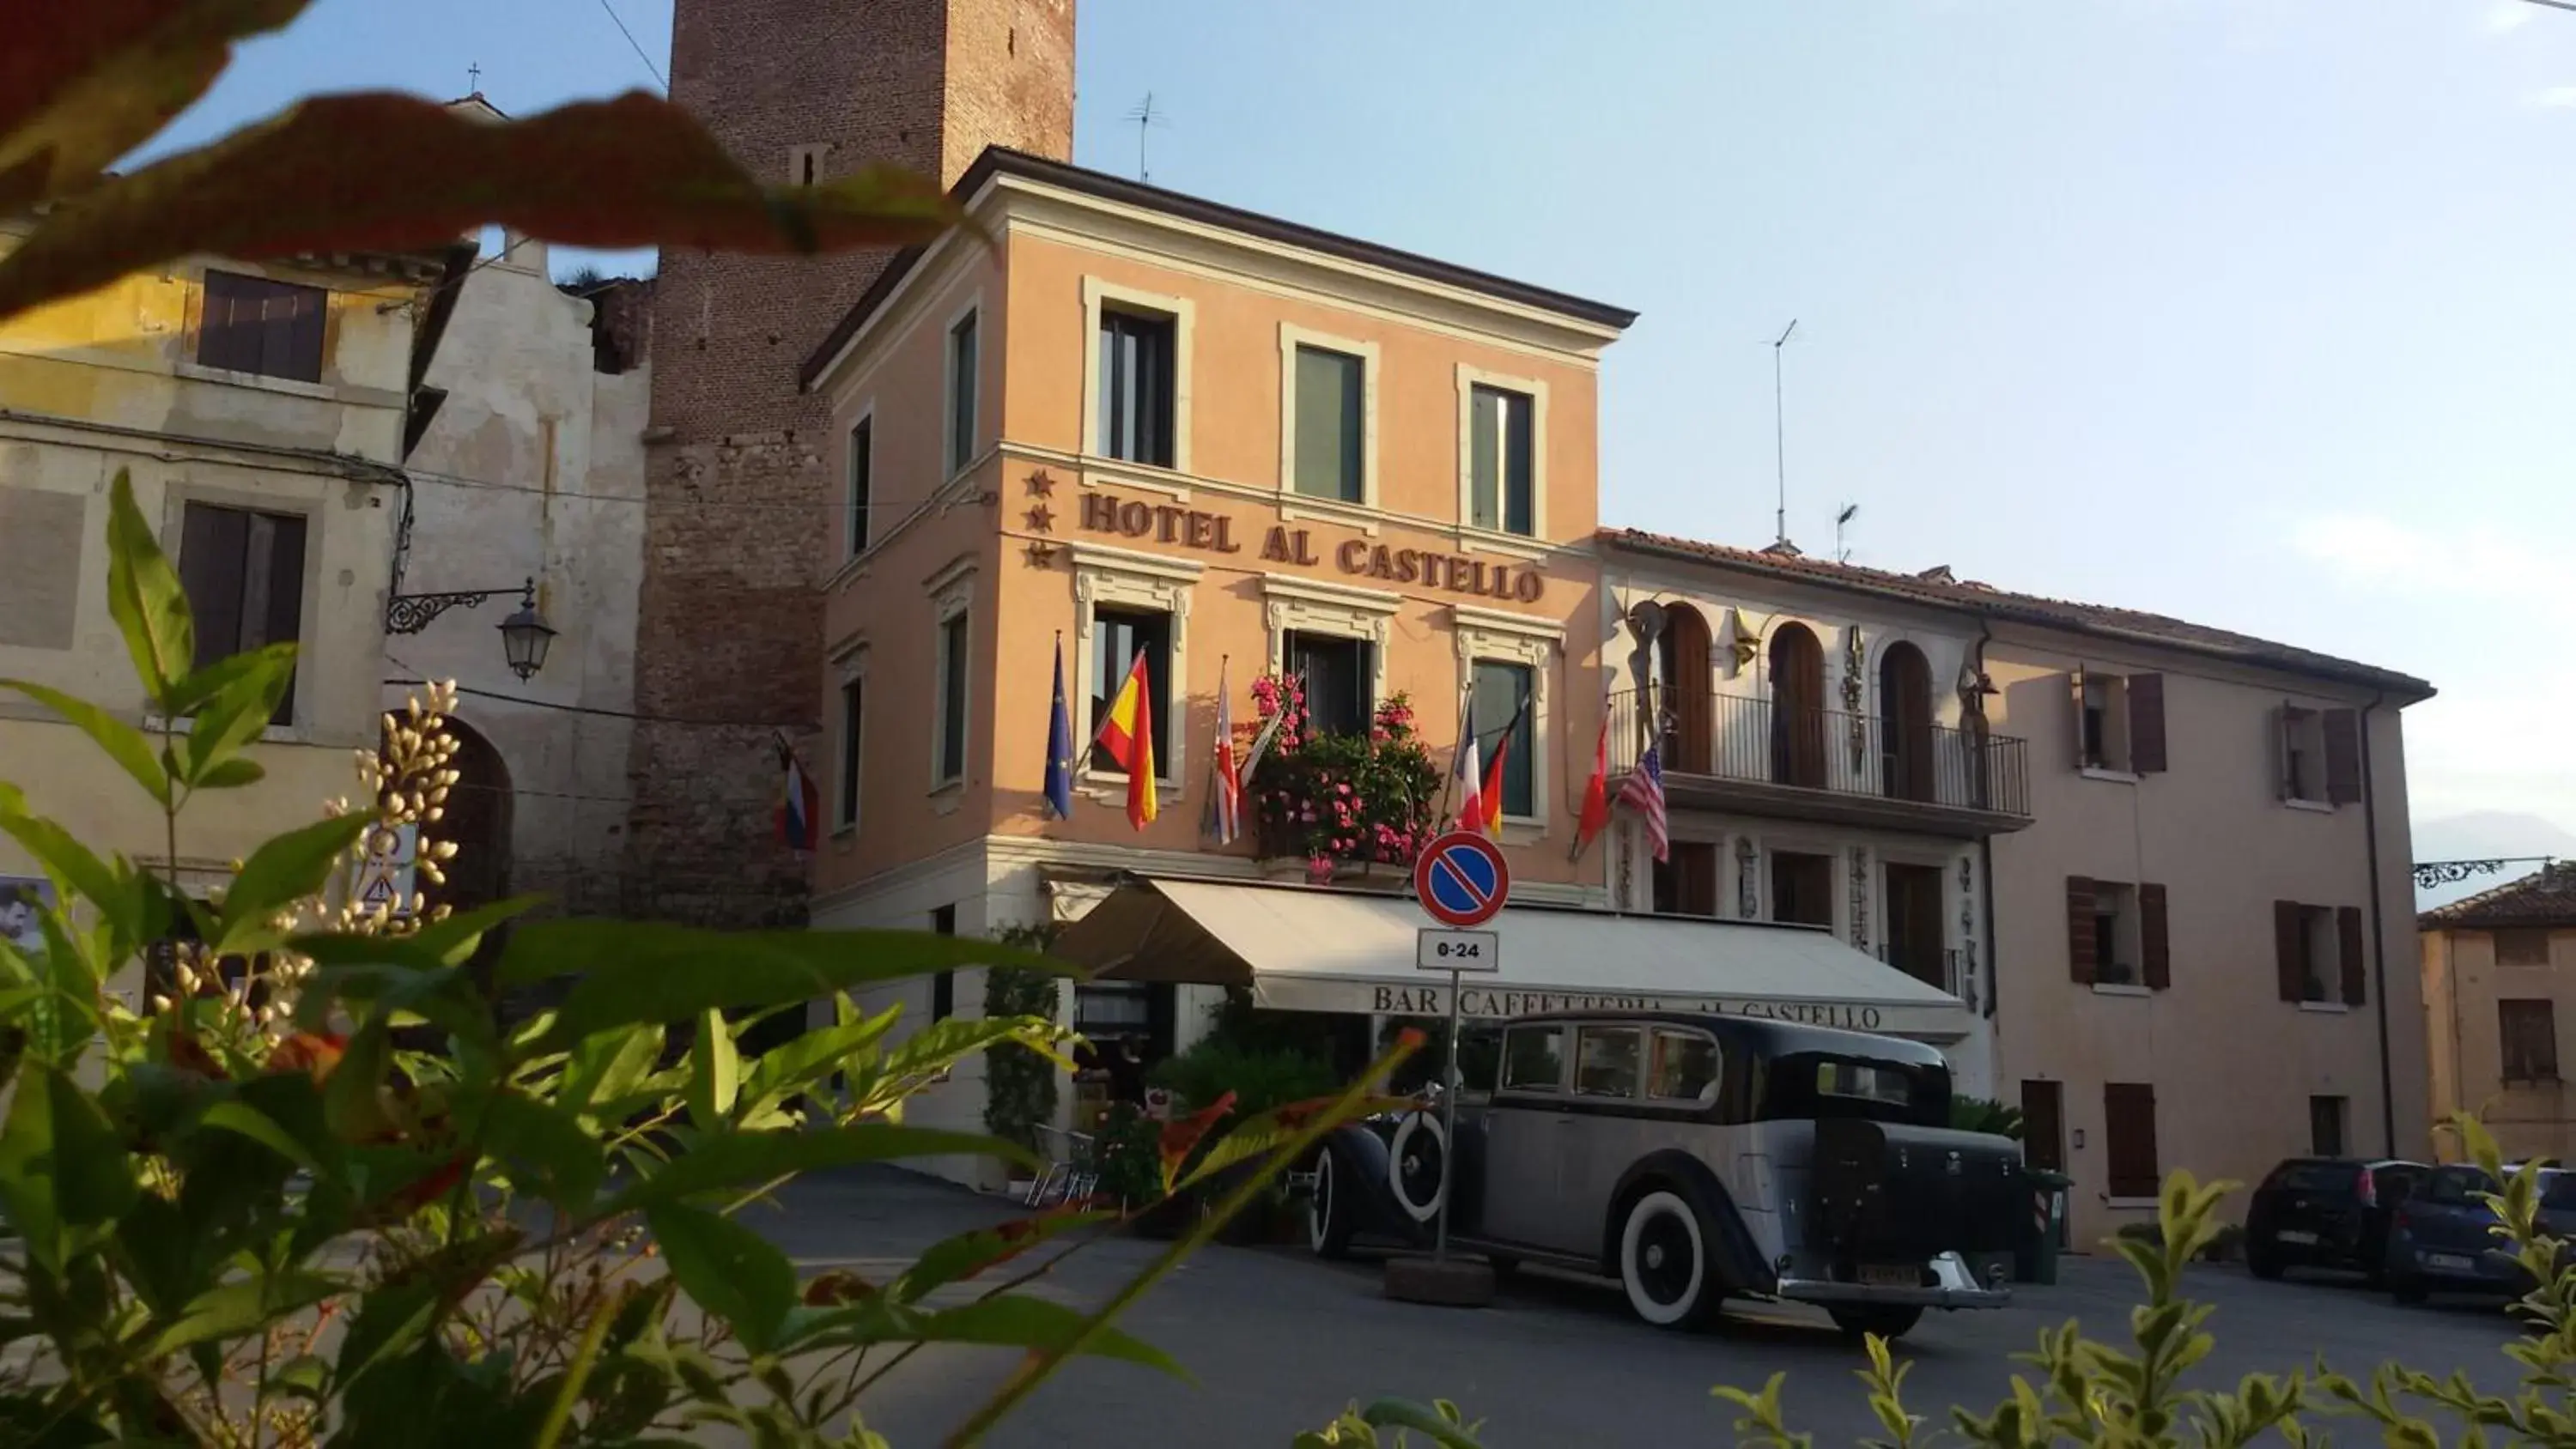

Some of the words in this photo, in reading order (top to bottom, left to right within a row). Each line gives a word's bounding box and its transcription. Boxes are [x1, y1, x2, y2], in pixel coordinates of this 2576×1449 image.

[1078, 493, 1241, 554] HOTEL
[1259, 525, 1319, 566] AL
[1335, 539, 1545, 603] CASTELLO
[1437, 942, 1479, 958] 0-24
[1374, 986, 1438, 1013] BAR
